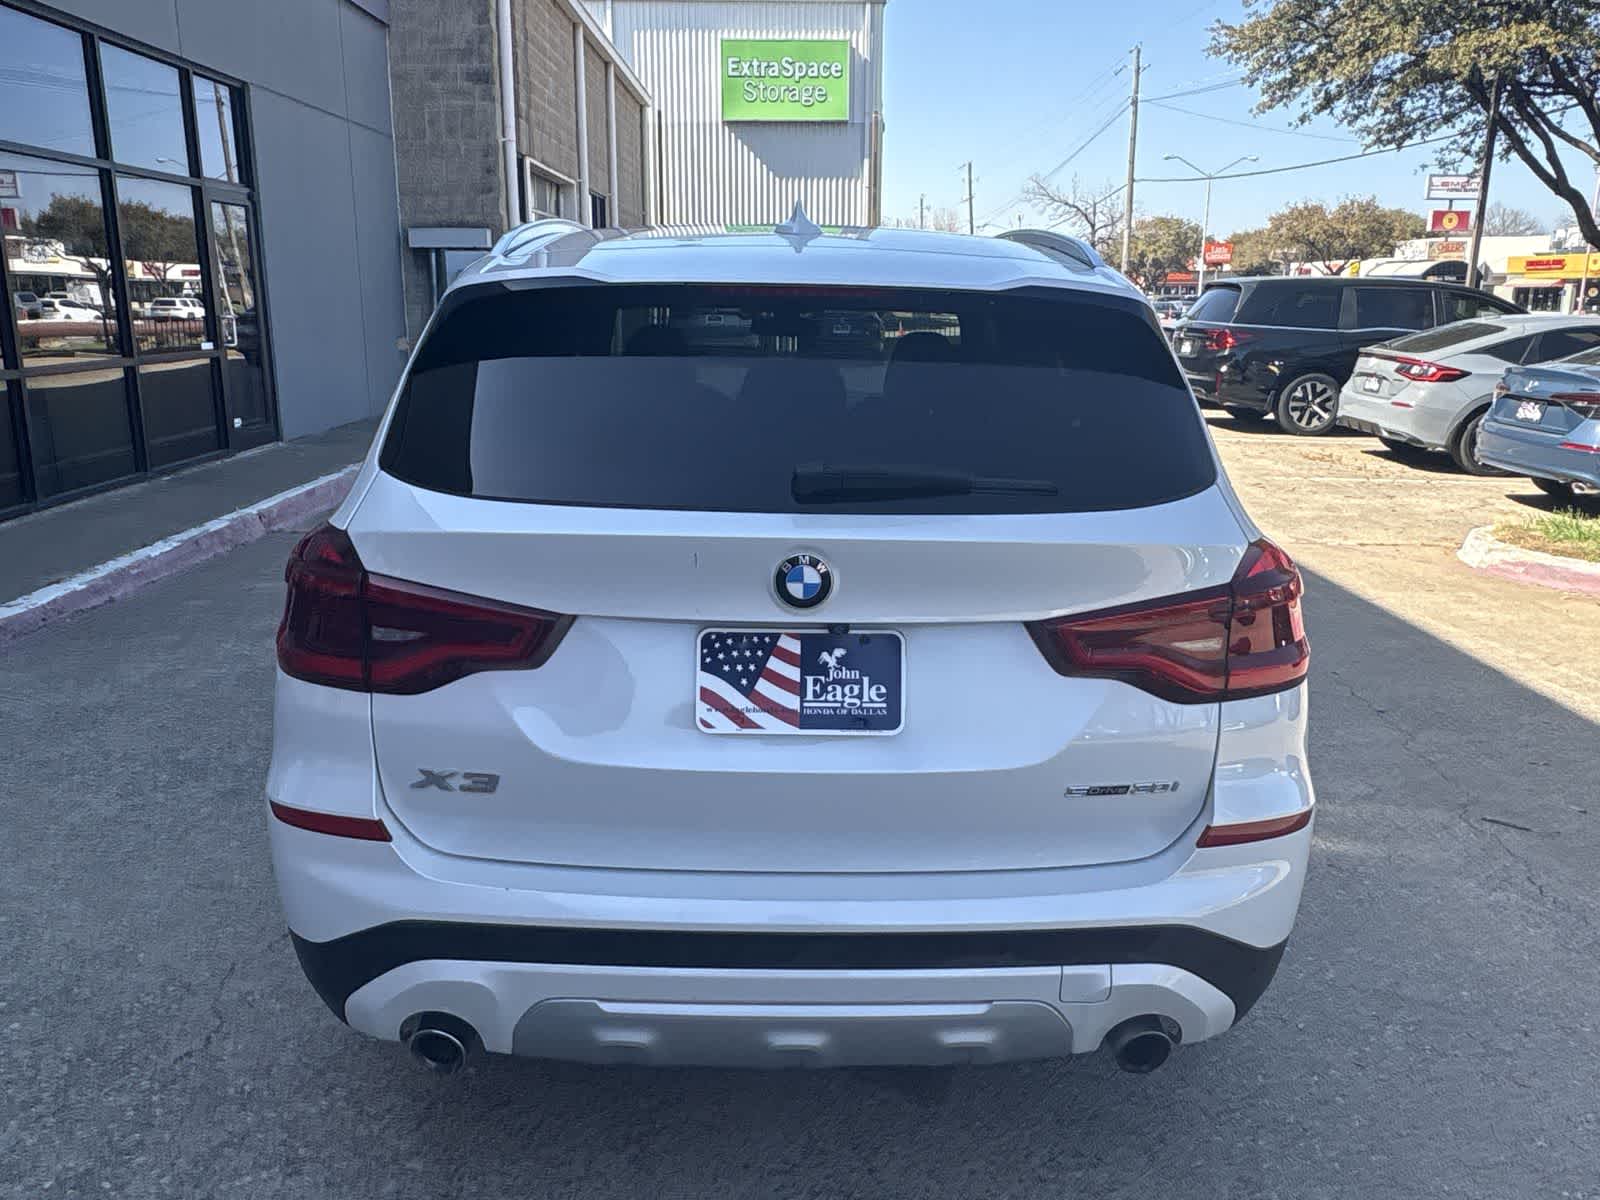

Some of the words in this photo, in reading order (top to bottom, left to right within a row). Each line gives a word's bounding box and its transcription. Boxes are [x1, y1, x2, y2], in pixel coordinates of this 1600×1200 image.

[727, 56, 842, 82] ExtraSpace
[743, 80, 827, 106] Storage
[781, 555, 828, 574] BMW
[826, 667, 860, 682] John
[803, 675, 887, 709] Eagle
[803, 707, 835, 716] HONDA
[837, 707, 847, 716] OF
[851, 707, 888, 716] DALLAS
[409, 767, 500, 793] X3
